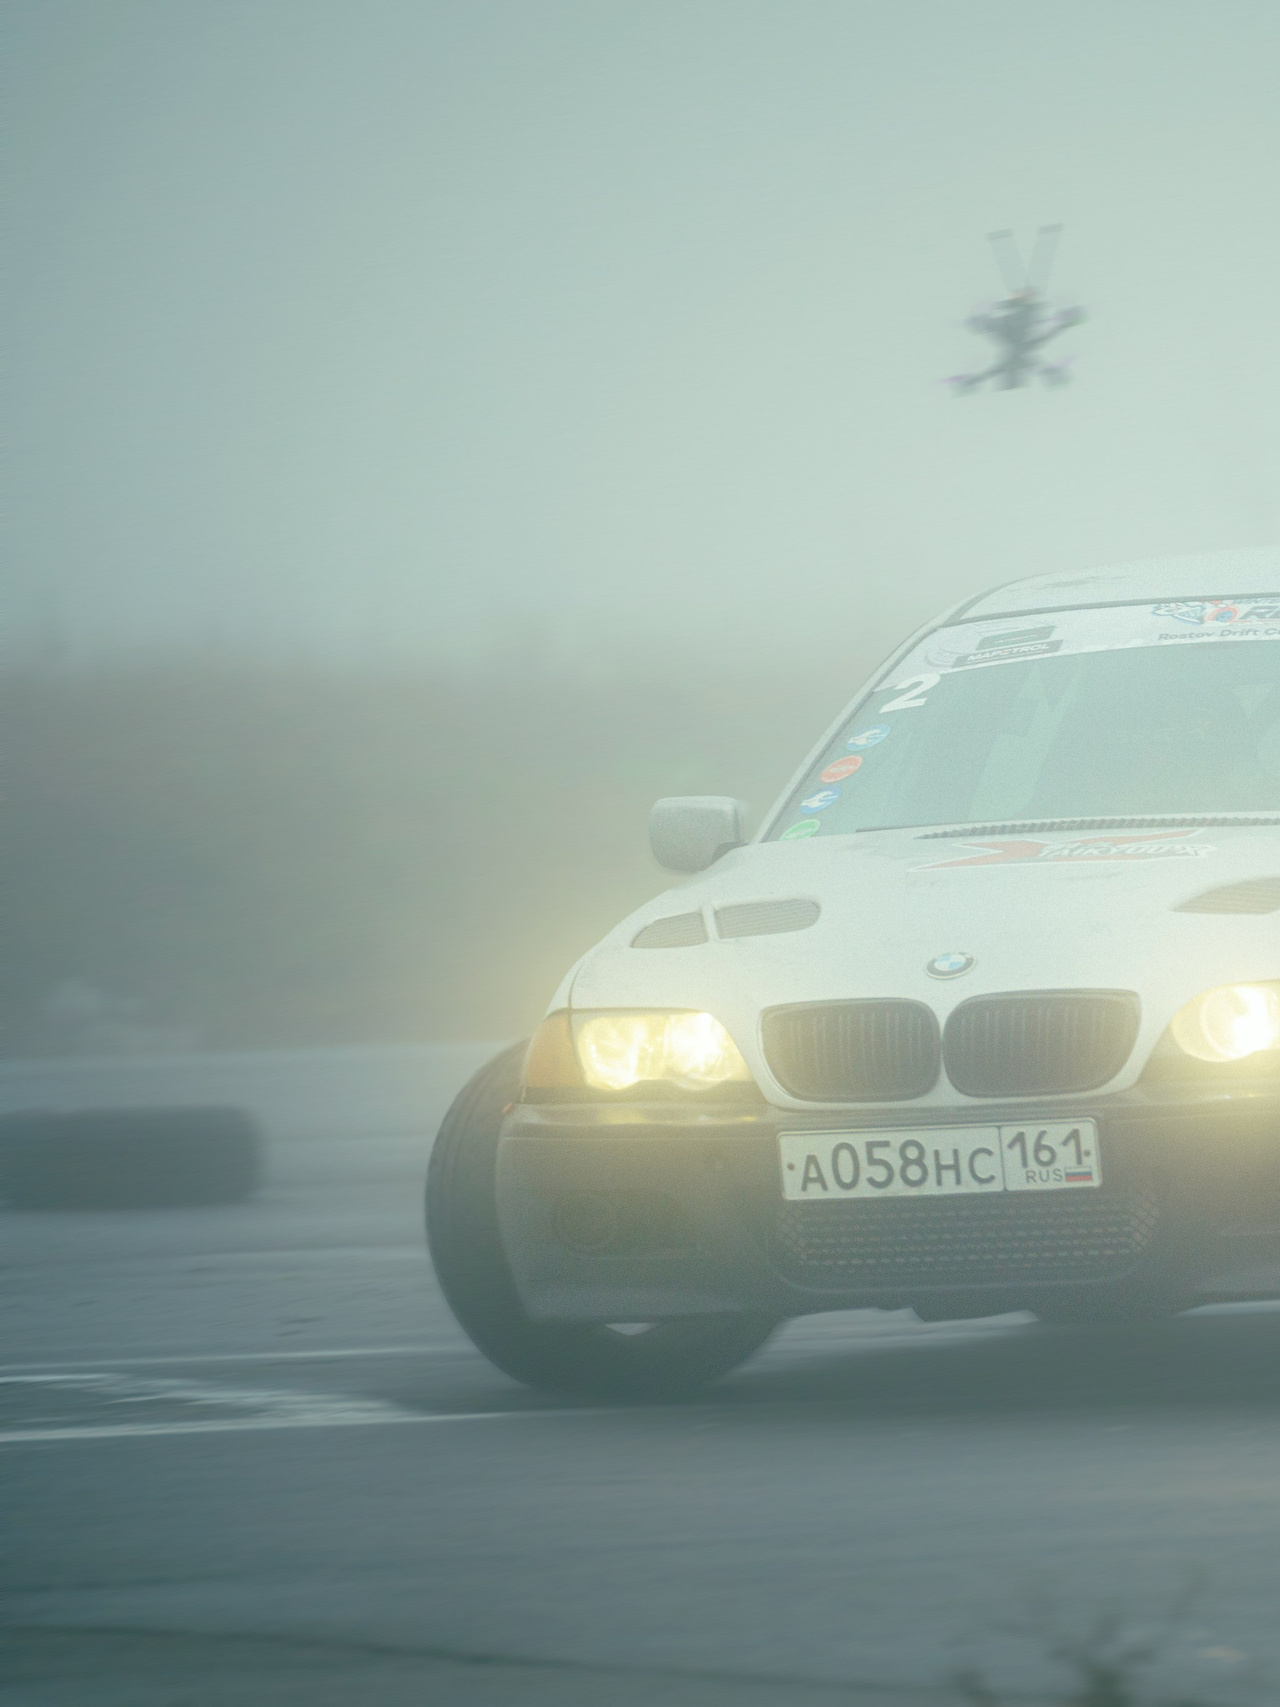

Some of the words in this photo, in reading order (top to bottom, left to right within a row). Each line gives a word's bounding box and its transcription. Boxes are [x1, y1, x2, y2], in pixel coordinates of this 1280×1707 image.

[1157, 632, 1214, 641] Rostov
[1219, 628, 1260, 637] Drift
[878, 672, 942, 714] 2
[1006, 1128, 1083, 1169] 161
[1024, 1169, 1062, 1185] RUS
